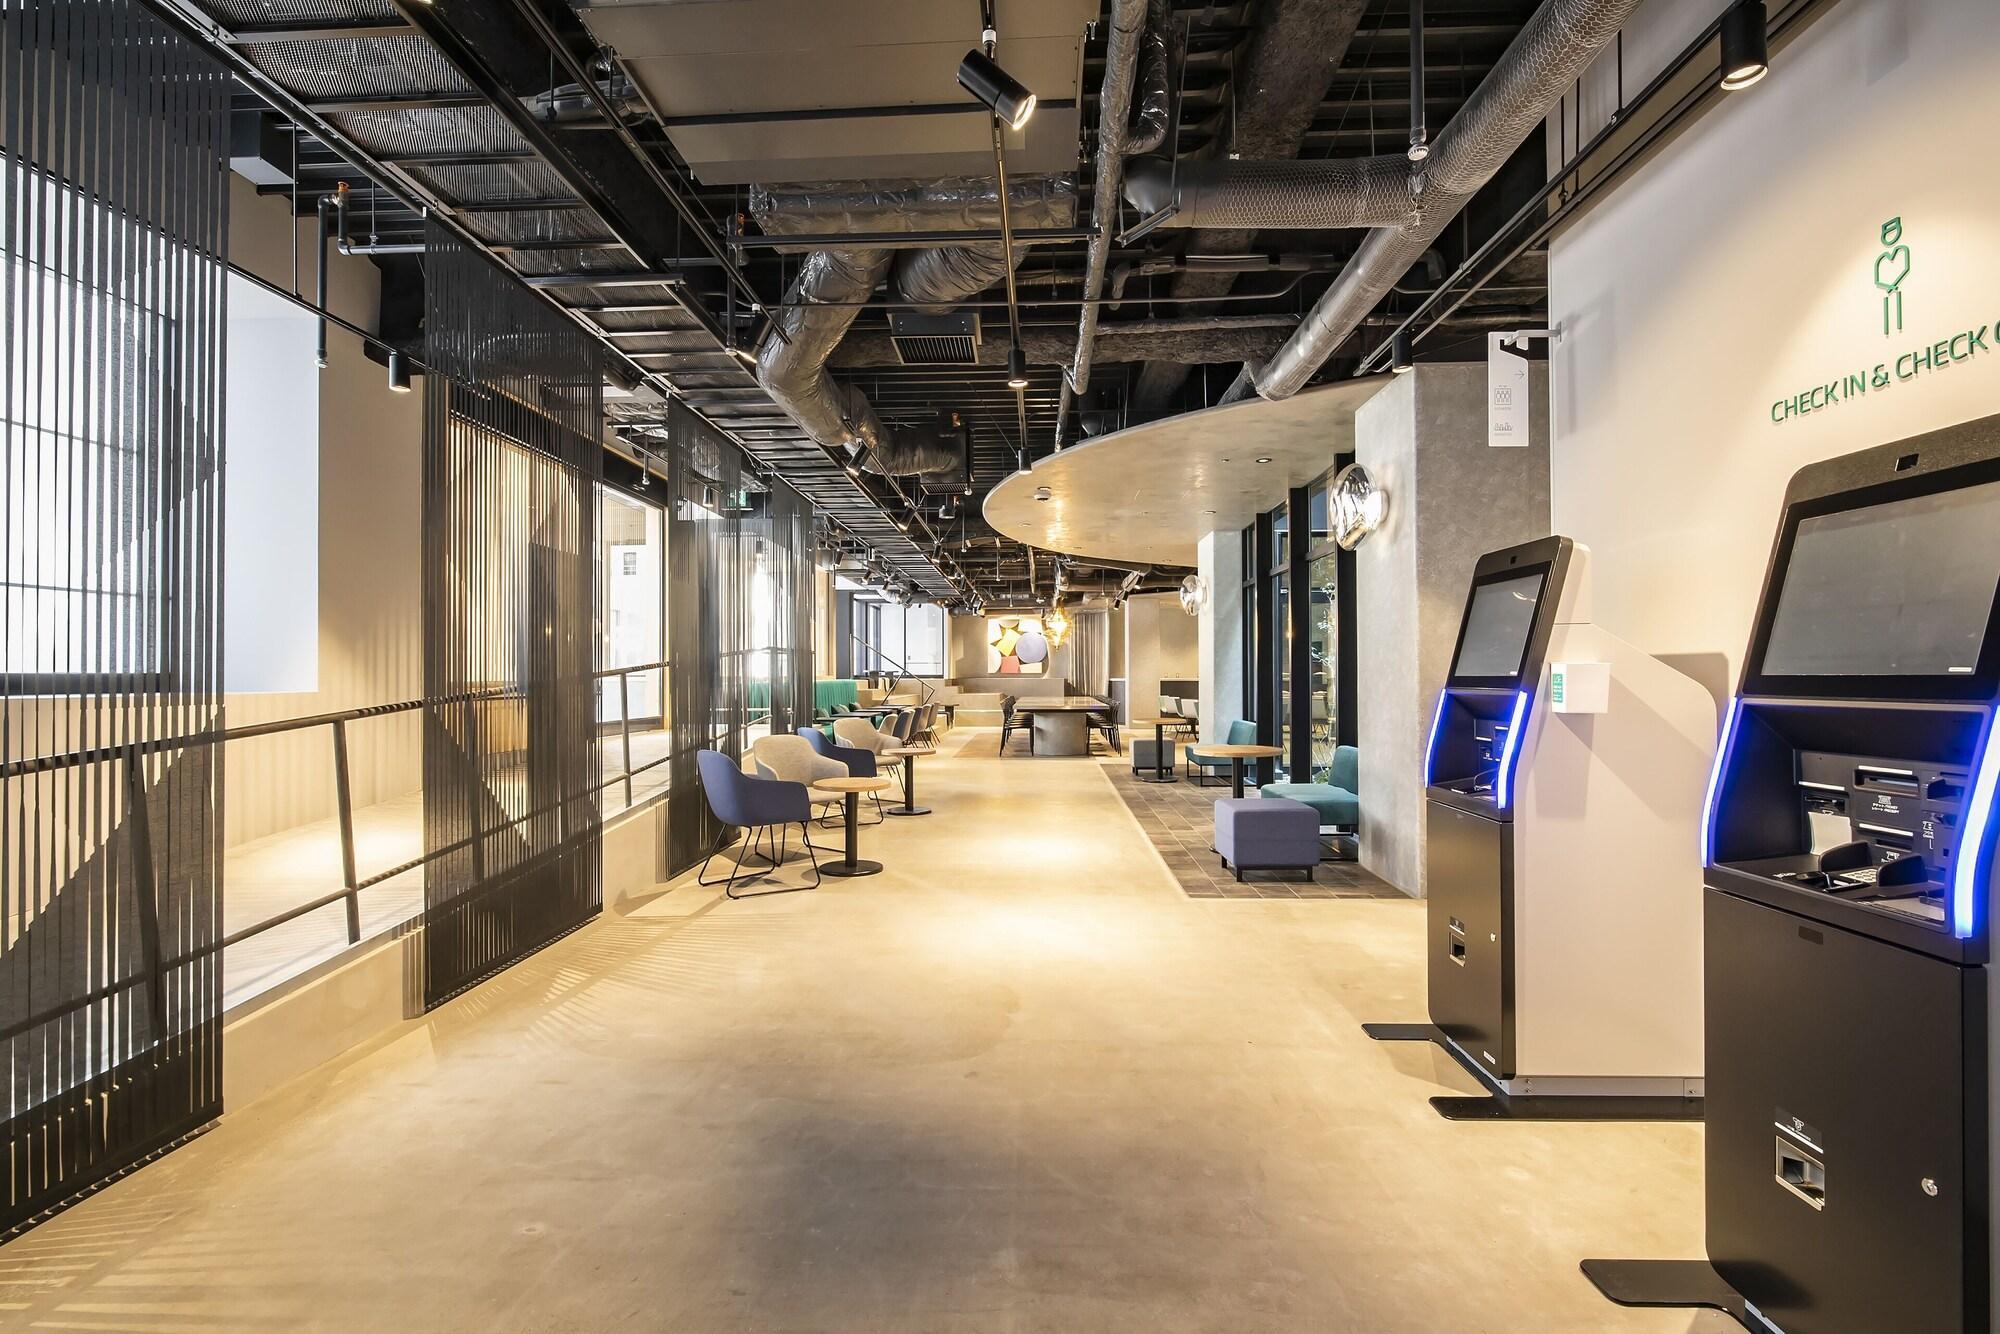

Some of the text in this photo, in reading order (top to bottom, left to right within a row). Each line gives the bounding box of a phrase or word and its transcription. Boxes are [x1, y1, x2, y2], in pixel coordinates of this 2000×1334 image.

[1771, 381, 1839, 423] CHECK
[1843, 370, 1866, 399] IN
[1871, 364, 1890, 388] &
[1896, 325, 1988, 379] CHECK
